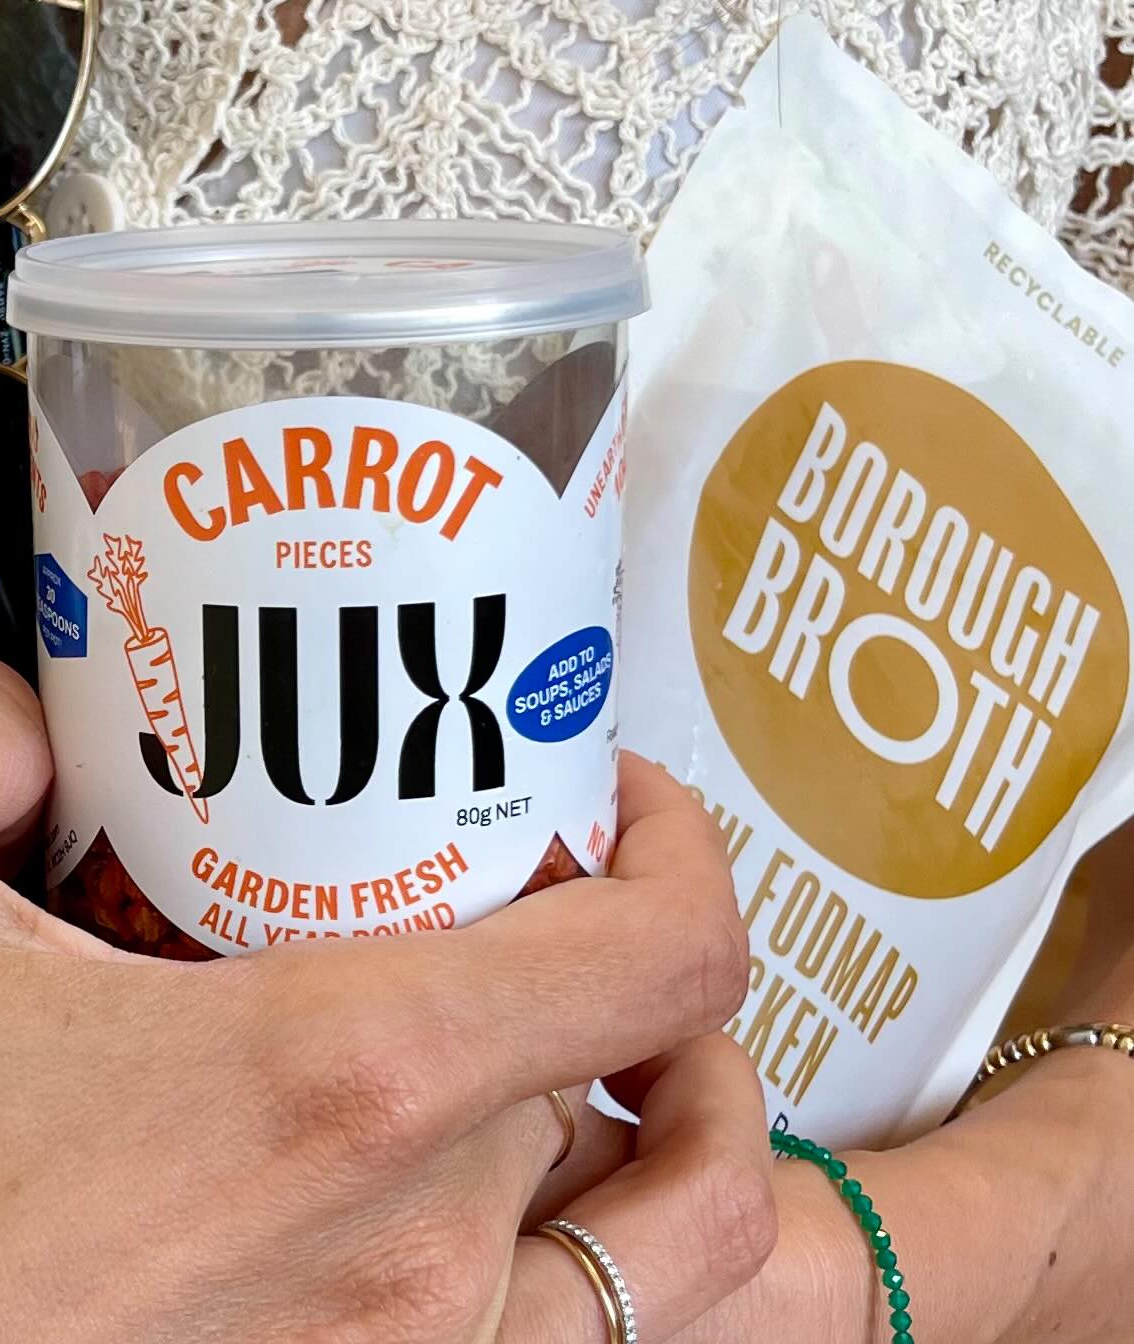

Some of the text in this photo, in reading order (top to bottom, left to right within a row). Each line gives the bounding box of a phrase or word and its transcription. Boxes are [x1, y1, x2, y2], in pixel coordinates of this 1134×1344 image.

[982, 241, 1125, 367] RECYCLABLE
[164, 426, 504, 542] CARROT
[275, 541, 373, 569] PIECES
[776, 401, 1100, 717] BOROUGH
[138, 593, 506, 805] JUX
[514, 652, 612, 714] SOUPS, SALADS
[540, 681, 602, 726] & SAUCES
[548, 646, 595, 682] ADD TO
[722, 517, 1052, 853] BROTH
[455, 796, 533, 828] 80g NET
[191, 842, 469, 921] GARDEN FRESH
[198, 902, 250, 948] ALL
[742, 847, 918, 1045] FODMAP
